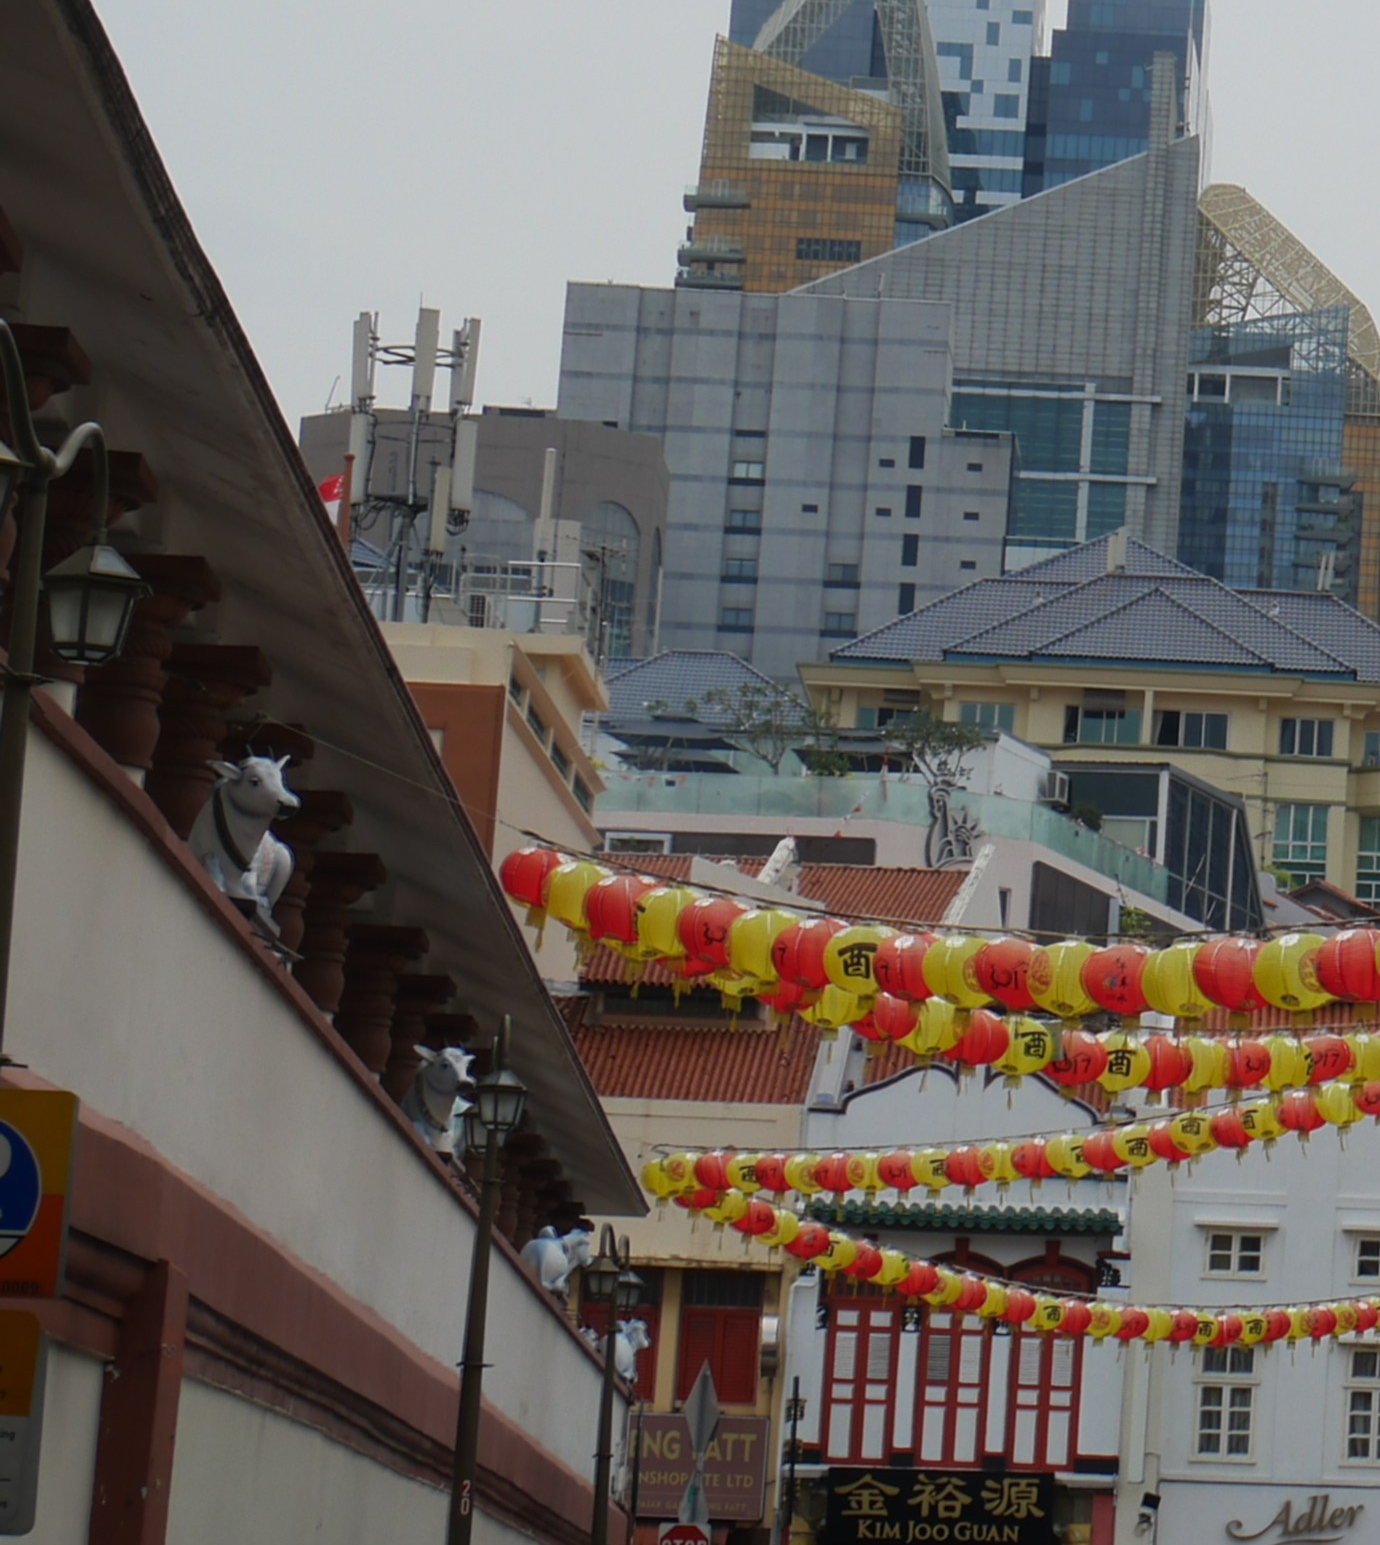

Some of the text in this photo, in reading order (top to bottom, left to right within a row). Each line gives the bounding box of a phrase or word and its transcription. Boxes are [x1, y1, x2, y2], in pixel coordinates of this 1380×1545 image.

[726, 1474, 754, 1489] LTD
[833, 1472, 1046, 1520] 金裕源
[856, 1518, 1020, 1544] KIM JOO GUAN
[1225, 1494, 1365, 1541] Adler
